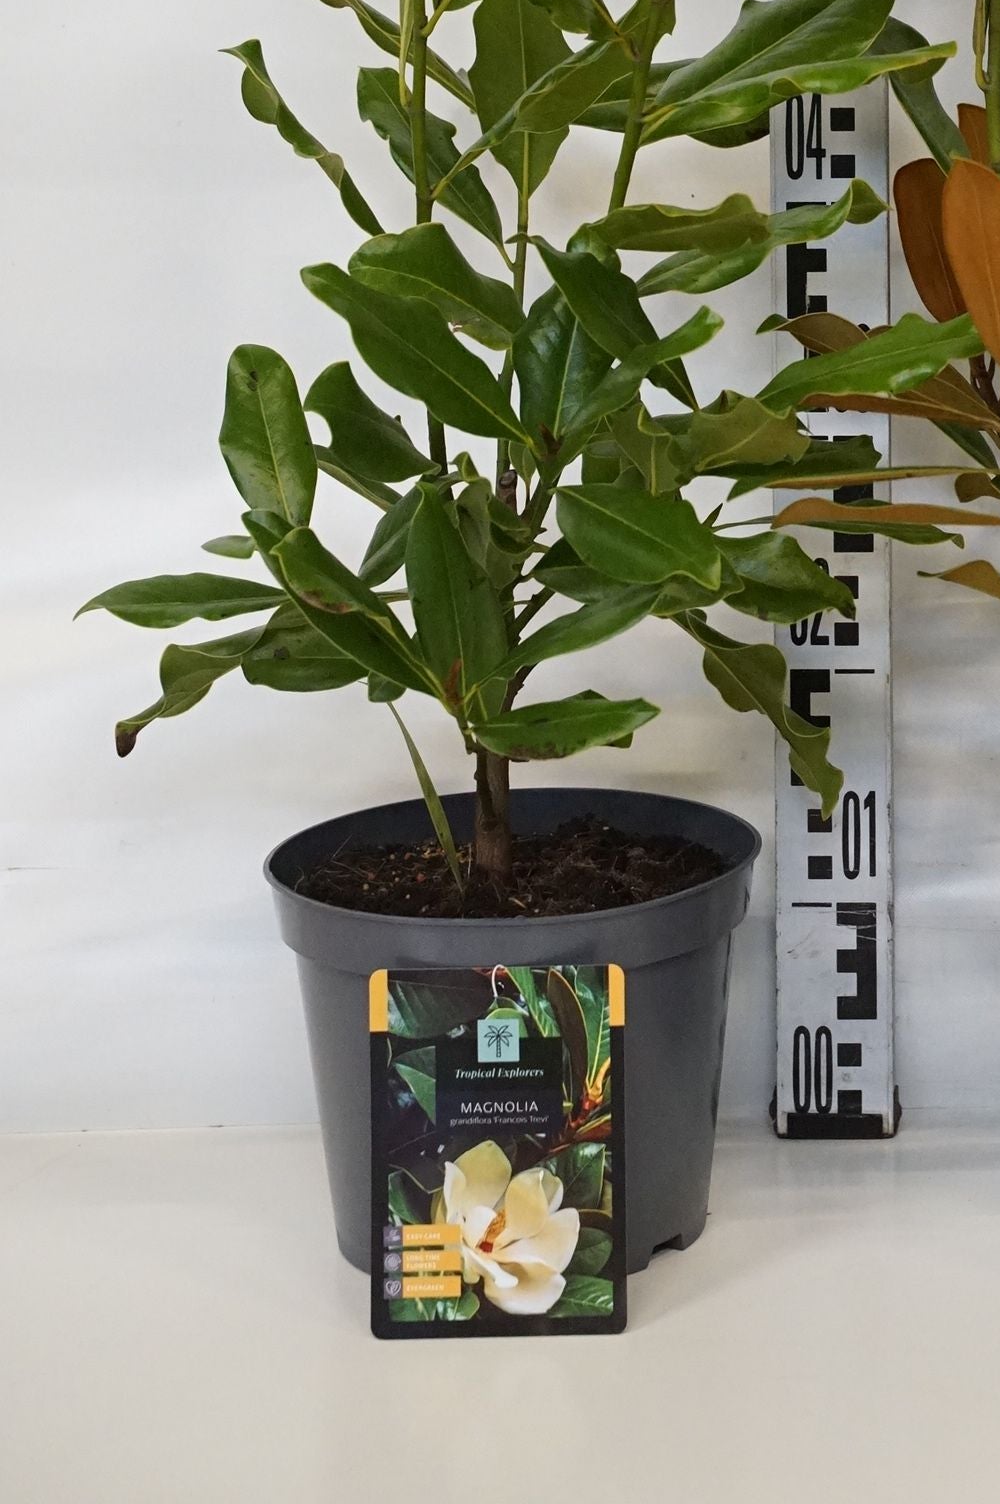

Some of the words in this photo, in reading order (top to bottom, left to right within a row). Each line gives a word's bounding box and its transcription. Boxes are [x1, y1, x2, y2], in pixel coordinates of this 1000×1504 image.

[785, 93, 826, 180] 04
[842, 790, 877, 880] 01
[455, 1067, 496, 1079] Tropical
[497, 1067, 544, 1079] Explorers
[793, 1025, 833, 1114] 00
[450, 1116, 491, 1127] grandiflora
[460, 1100, 539, 1114] MAGNOLIA
